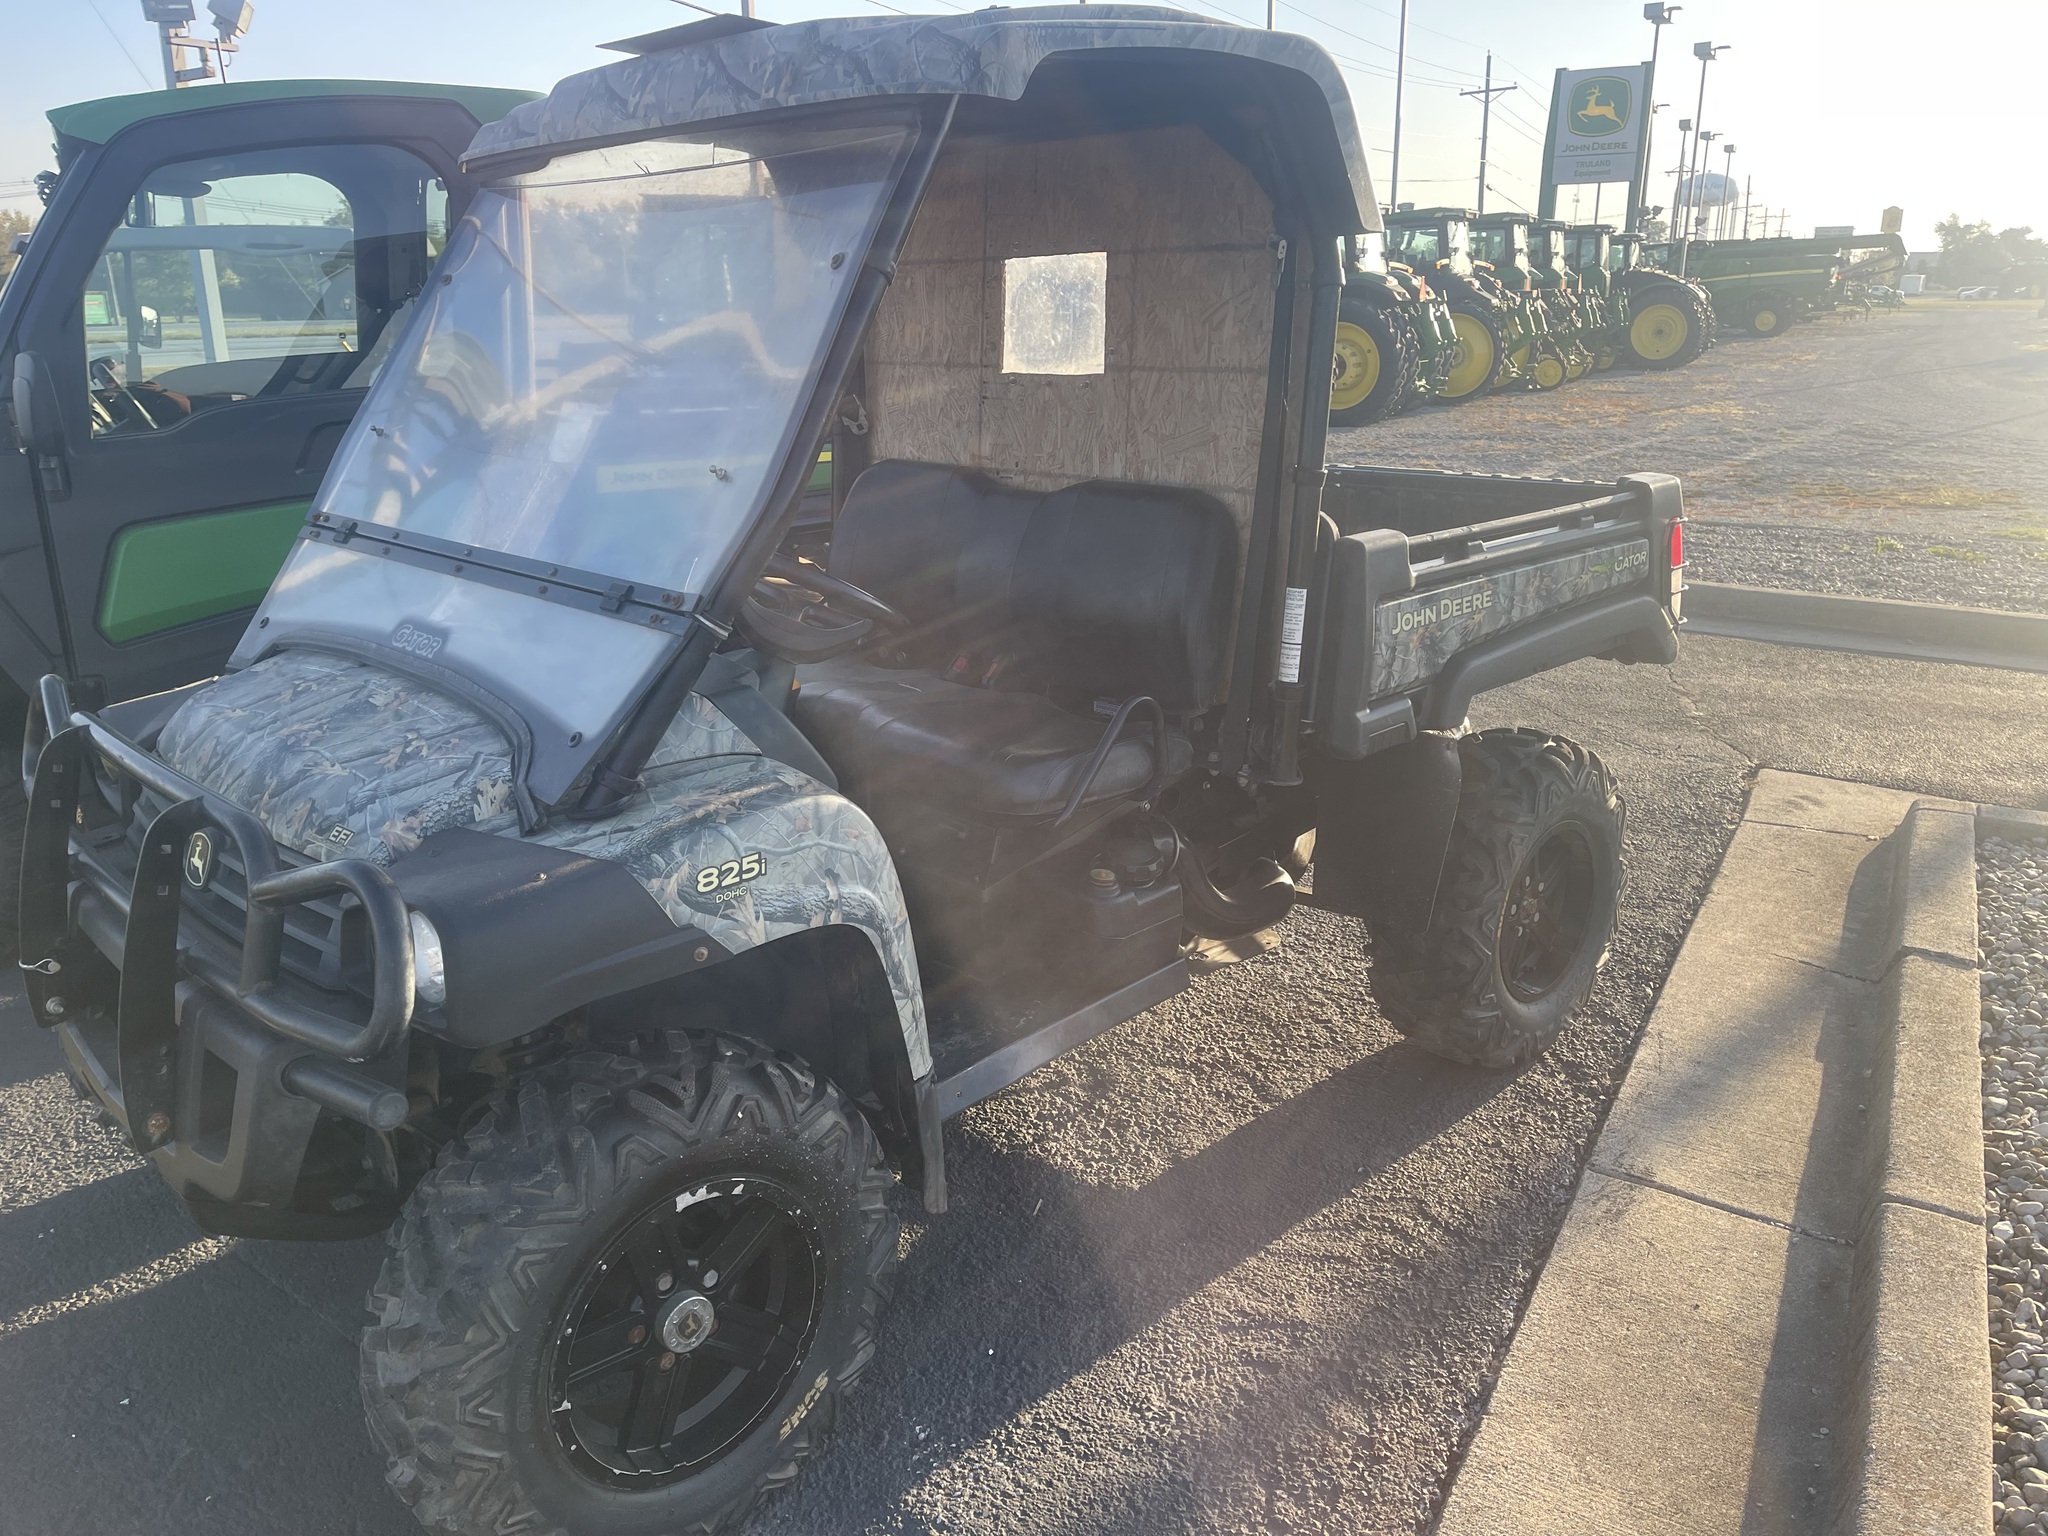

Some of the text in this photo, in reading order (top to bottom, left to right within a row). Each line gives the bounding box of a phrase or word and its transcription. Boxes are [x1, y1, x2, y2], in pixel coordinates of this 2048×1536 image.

[1562, 141, 1629, 153] JOHN DEERE
[1573, 168, 1611, 178] Equipment
[1575, 160, 1611, 169] TRULAND
[1614, 551, 1647, 572] GATOR
[1391, 590, 1493, 635] JOHN DEERE
[391, 624, 443, 658] GATOR
[328, 824, 355, 847] EFI
[696, 852, 767, 894] 825i
[715, 886, 748, 904] DOHC
